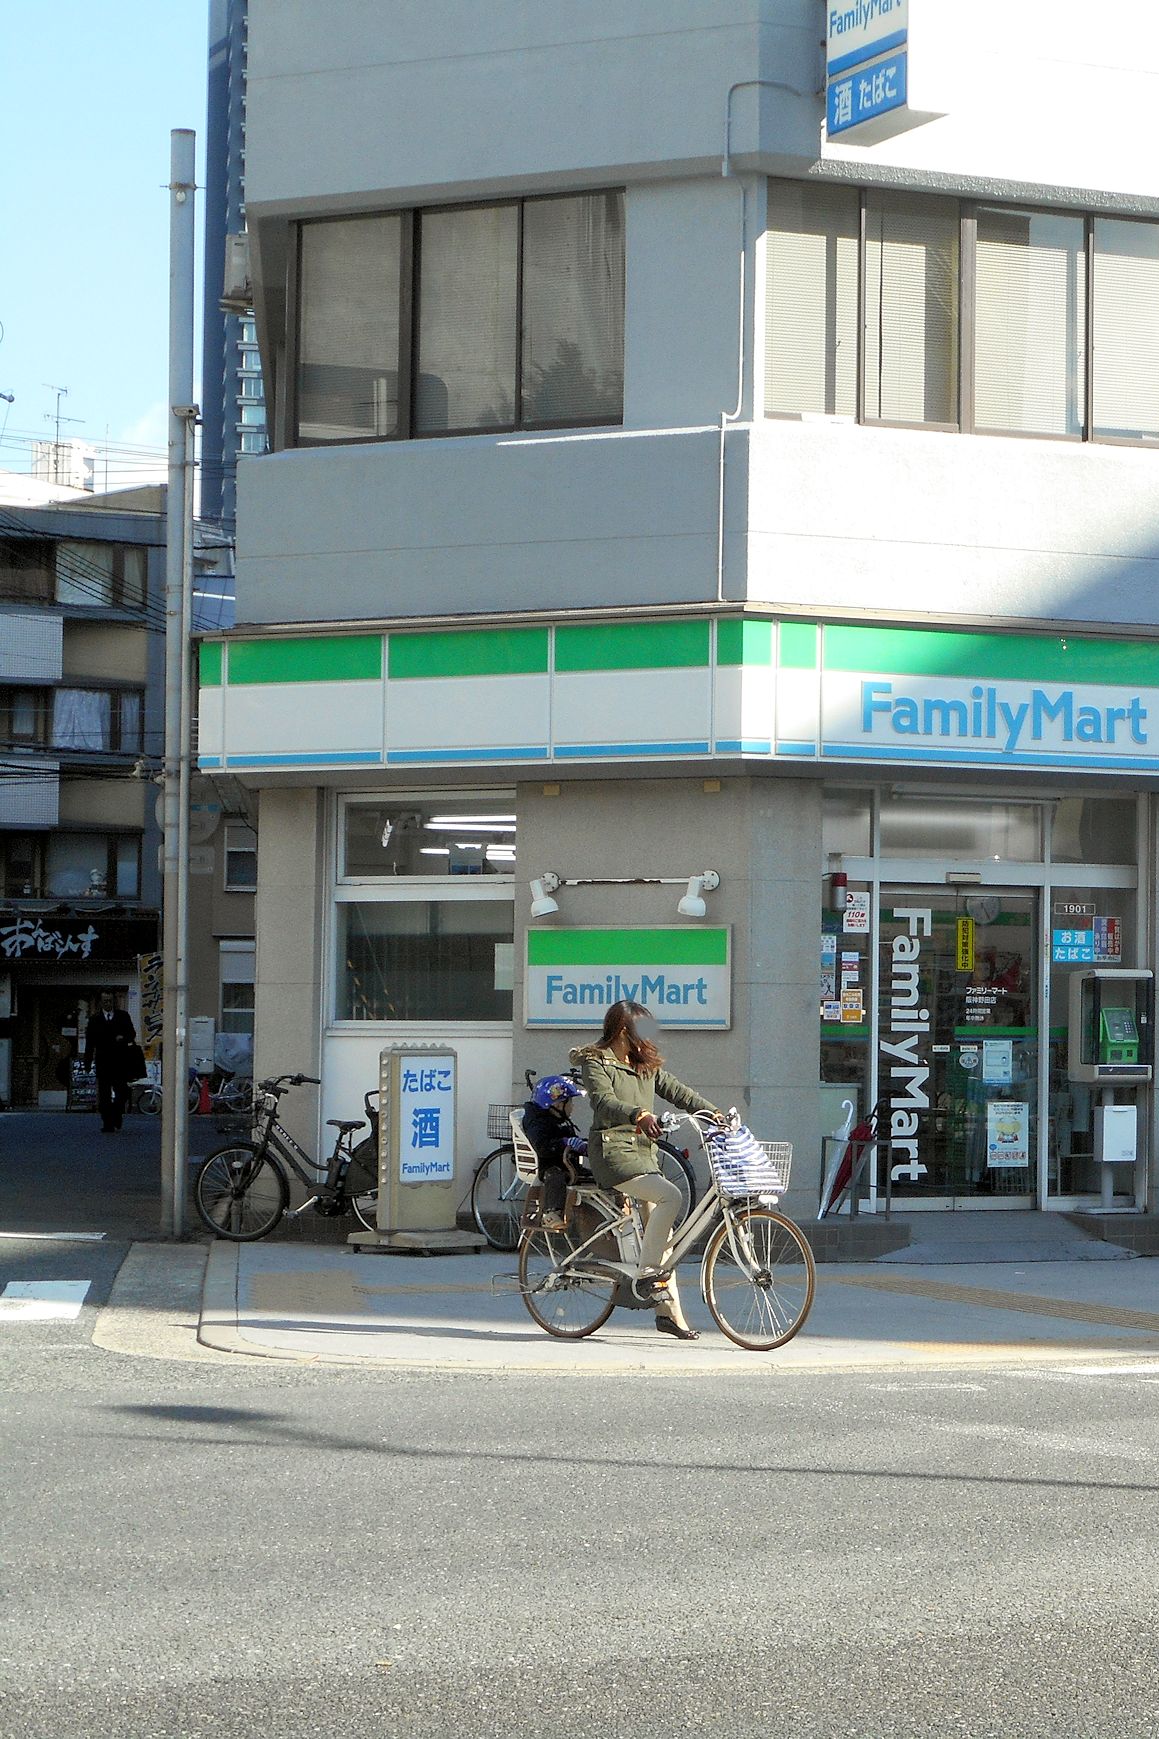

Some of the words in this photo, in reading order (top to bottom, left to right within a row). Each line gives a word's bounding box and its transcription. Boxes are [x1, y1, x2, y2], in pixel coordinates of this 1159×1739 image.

[834, 80, 852, 125] 酒
[858, 67, 897, 110] たばこ
[861, 680, 1148, 753] FamilyMart
[1063, 904, 1086, 913] 1901
[1061, 931, 1086, 945] お酒
[1055, 947, 1091, 960] たばこ
[546, 975, 708, 1005] FamilyMart
[966, 986, 1008, 995] ファミリーマート
[965, 996, 997, 1004] 阪神野田店
[880, 908, 932, 1181] FamilyMart
[402, 1070, 452, 1092] たばこ
[412, 1107, 441, 1148] 酒
[402, 1162, 450, 1176] FamilyMart
